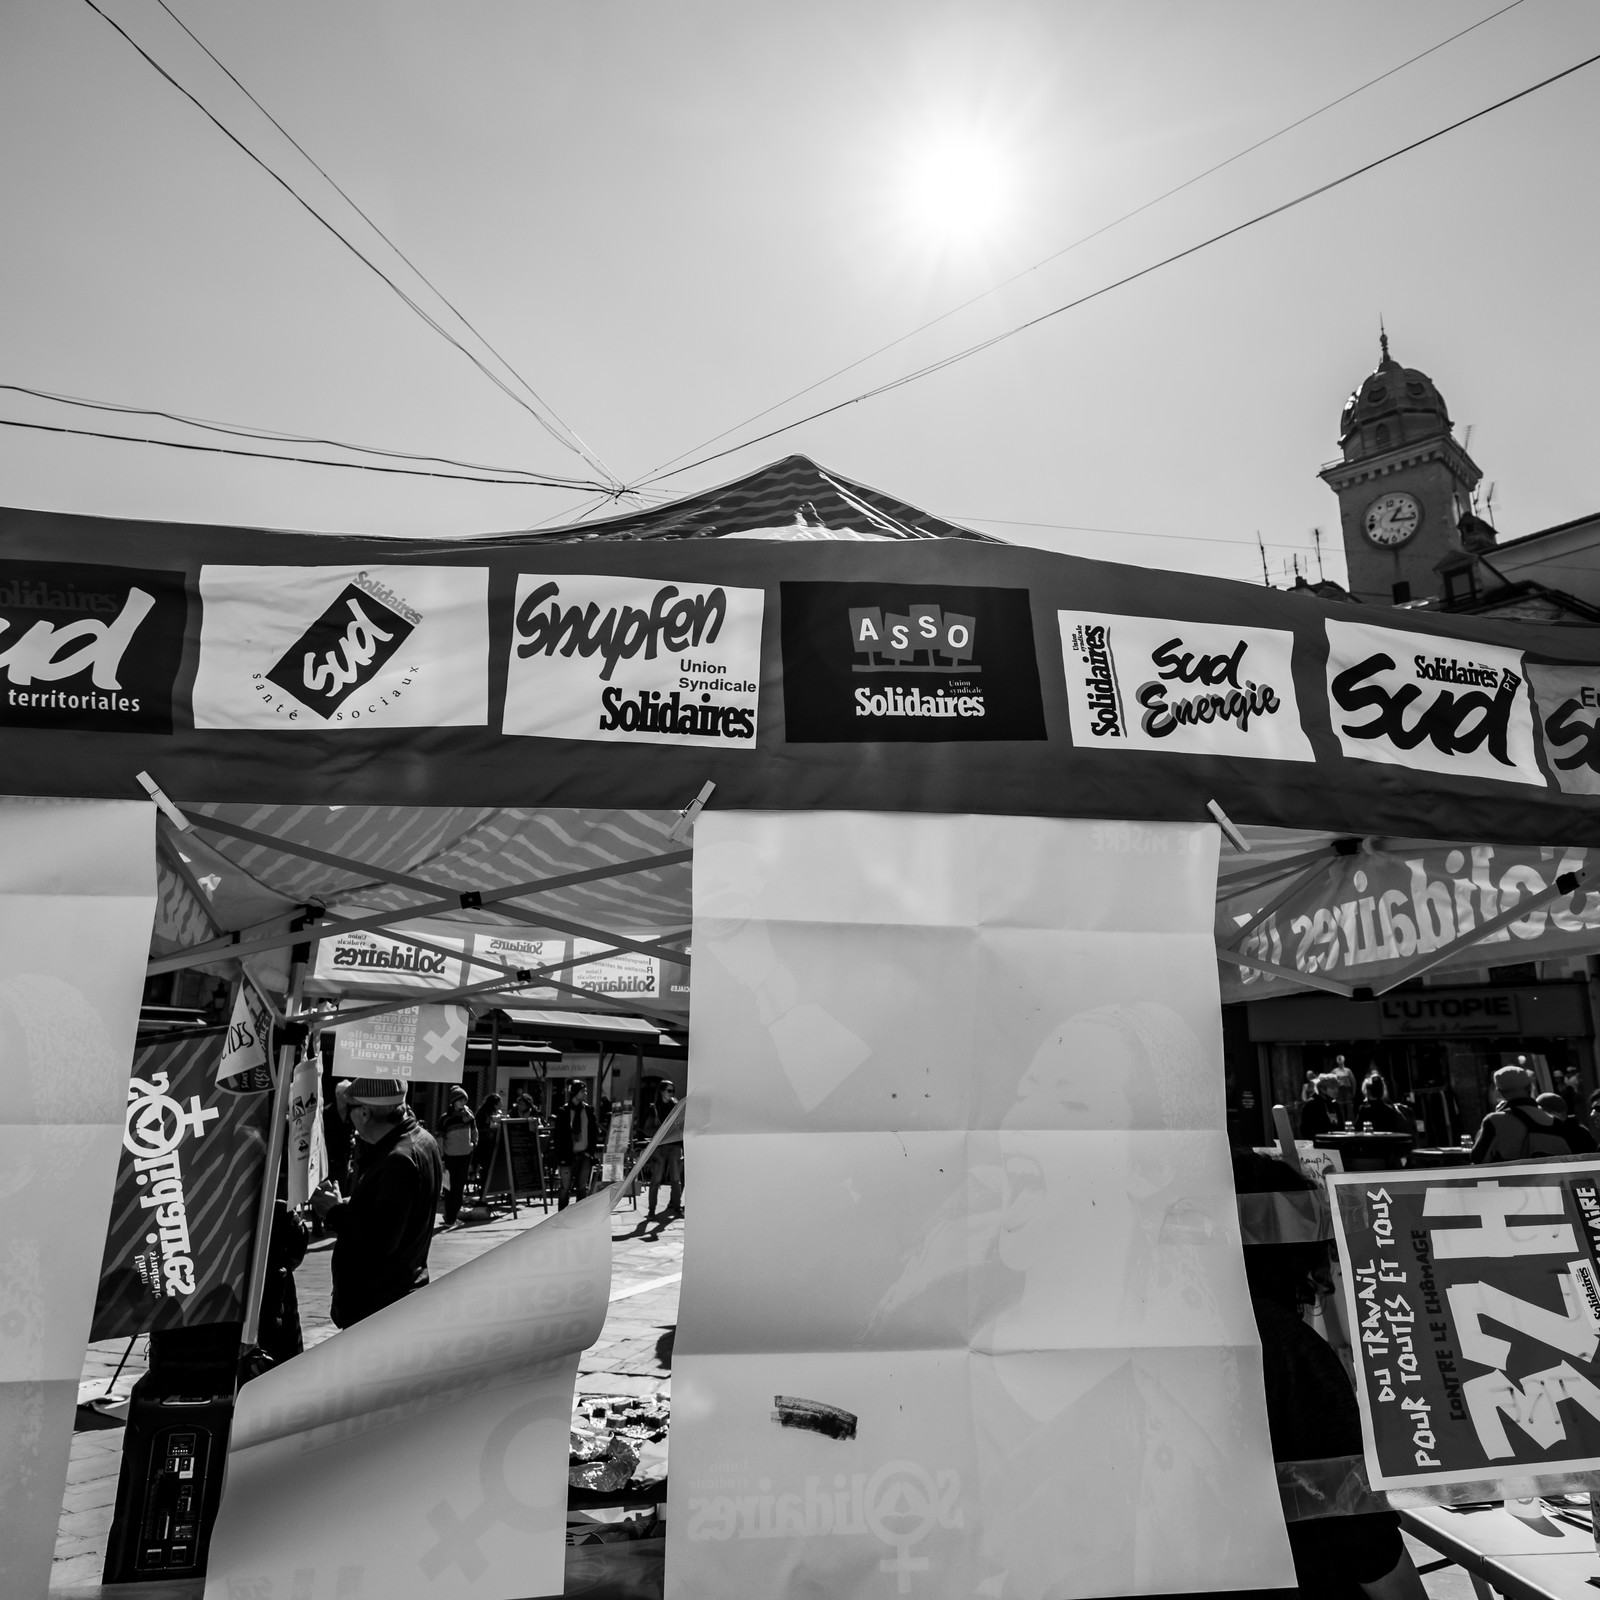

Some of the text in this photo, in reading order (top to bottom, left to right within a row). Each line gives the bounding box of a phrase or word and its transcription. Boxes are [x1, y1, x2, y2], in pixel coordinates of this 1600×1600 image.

[0, 580, 118, 612] olidaires
[352, 570, 424, 626] Solidaires
[0, 587, 156, 690] ud
[515, 581, 727, 681] Snupfen
[859, 615, 969, 649] ASSO
[1071, 632, 1079, 651] Union
[679, 658, 728, 675] Union
[948, 679, 971, 687] Union
[1082, 625, 1120, 737] Solidaires
[1415, 654, 1500, 691] Solidaires
[8, 689, 141, 713] territoriales
[336, 664, 420, 722] sociaux
[678, 677, 757, 694] Syndicale
[854, 686, 986, 717] Solidaires
[949, 686, 983, 696] syndicale
[1581, 686, 1600, 708] E
[599, 686, 756, 740] Solidaires
[1135, 679, 1281, 739] Energie
[1545, 698, 1600, 774] S
[1382, 996, 1512, 1019] L'UTOPIE
[1578, 1267, 1600, 1321] Solidaires
[1366, 1187, 1442, 1467] POUR TOUTES ET TOUS
[1429, 1321, 1447, 1343] LE
[1374, 1368, 1396, 1402] DU
